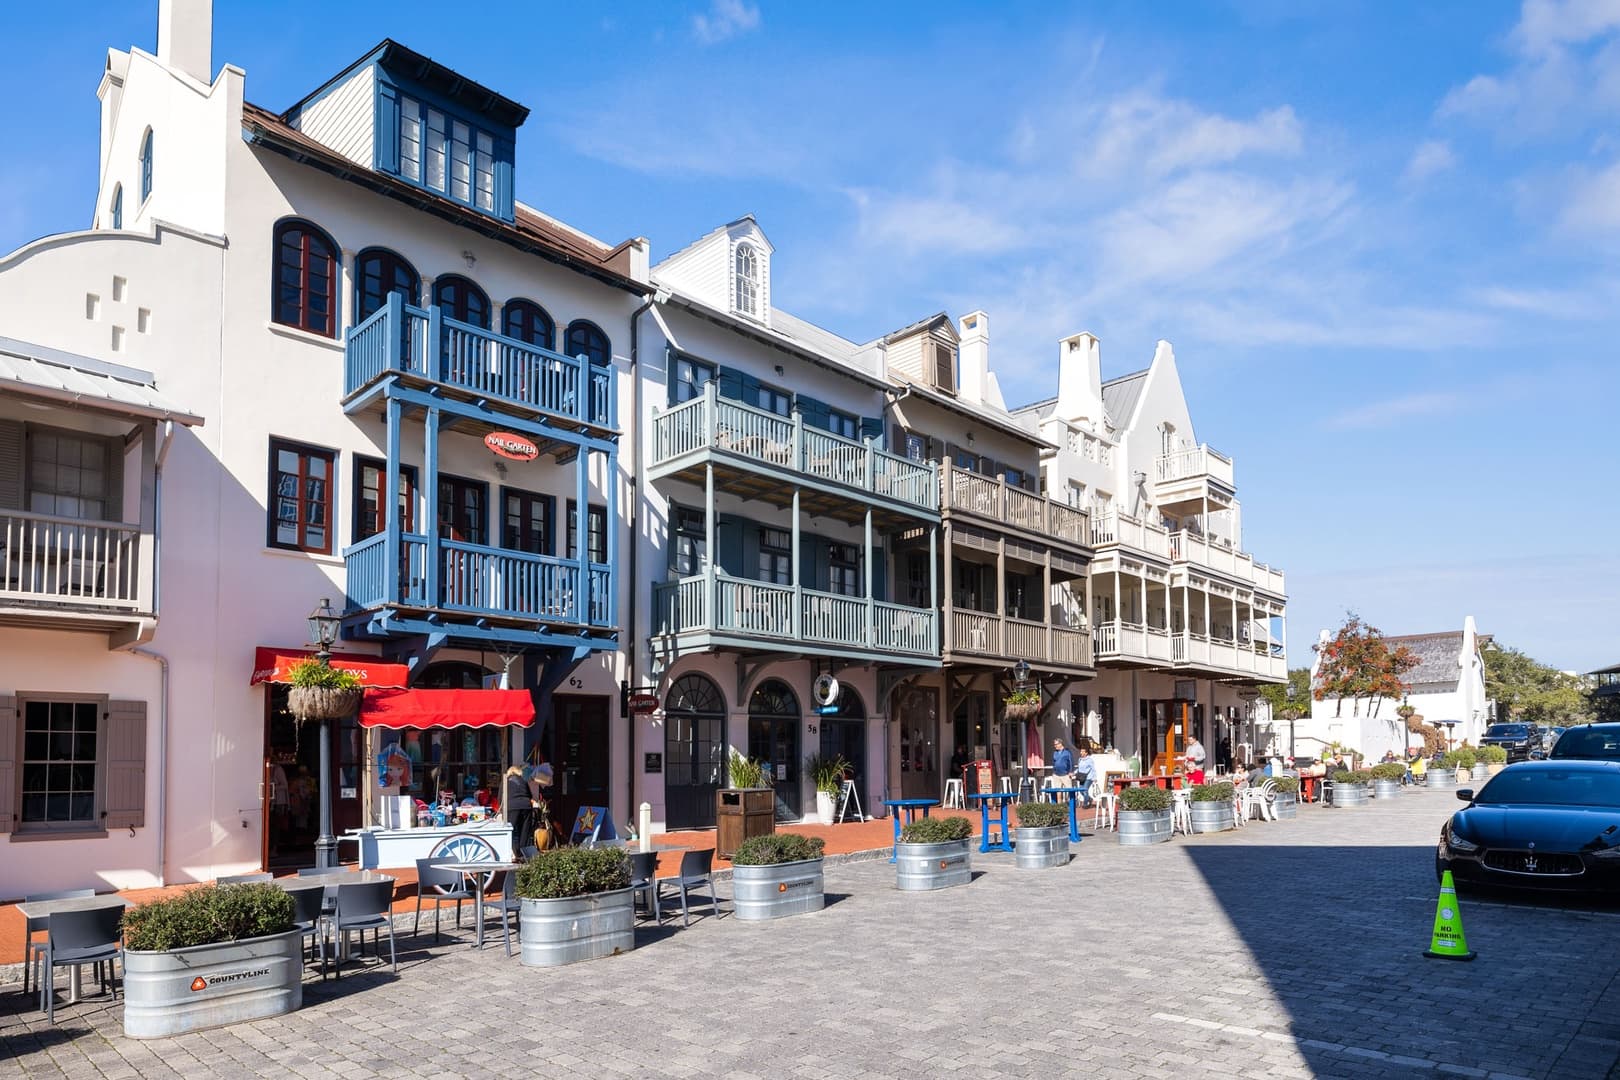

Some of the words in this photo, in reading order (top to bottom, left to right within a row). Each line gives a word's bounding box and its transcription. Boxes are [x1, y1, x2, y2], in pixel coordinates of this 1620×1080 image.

[488, 436, 505, 447] NAIL
[506, 440, 537, 454] GARTEN
[569, 676, 583, 689] 62
[807, 724, 817, 734] 58
[1434, 932, 1461, 940] PARKING
[209, 968, 270, 985] COUNTYLINE
